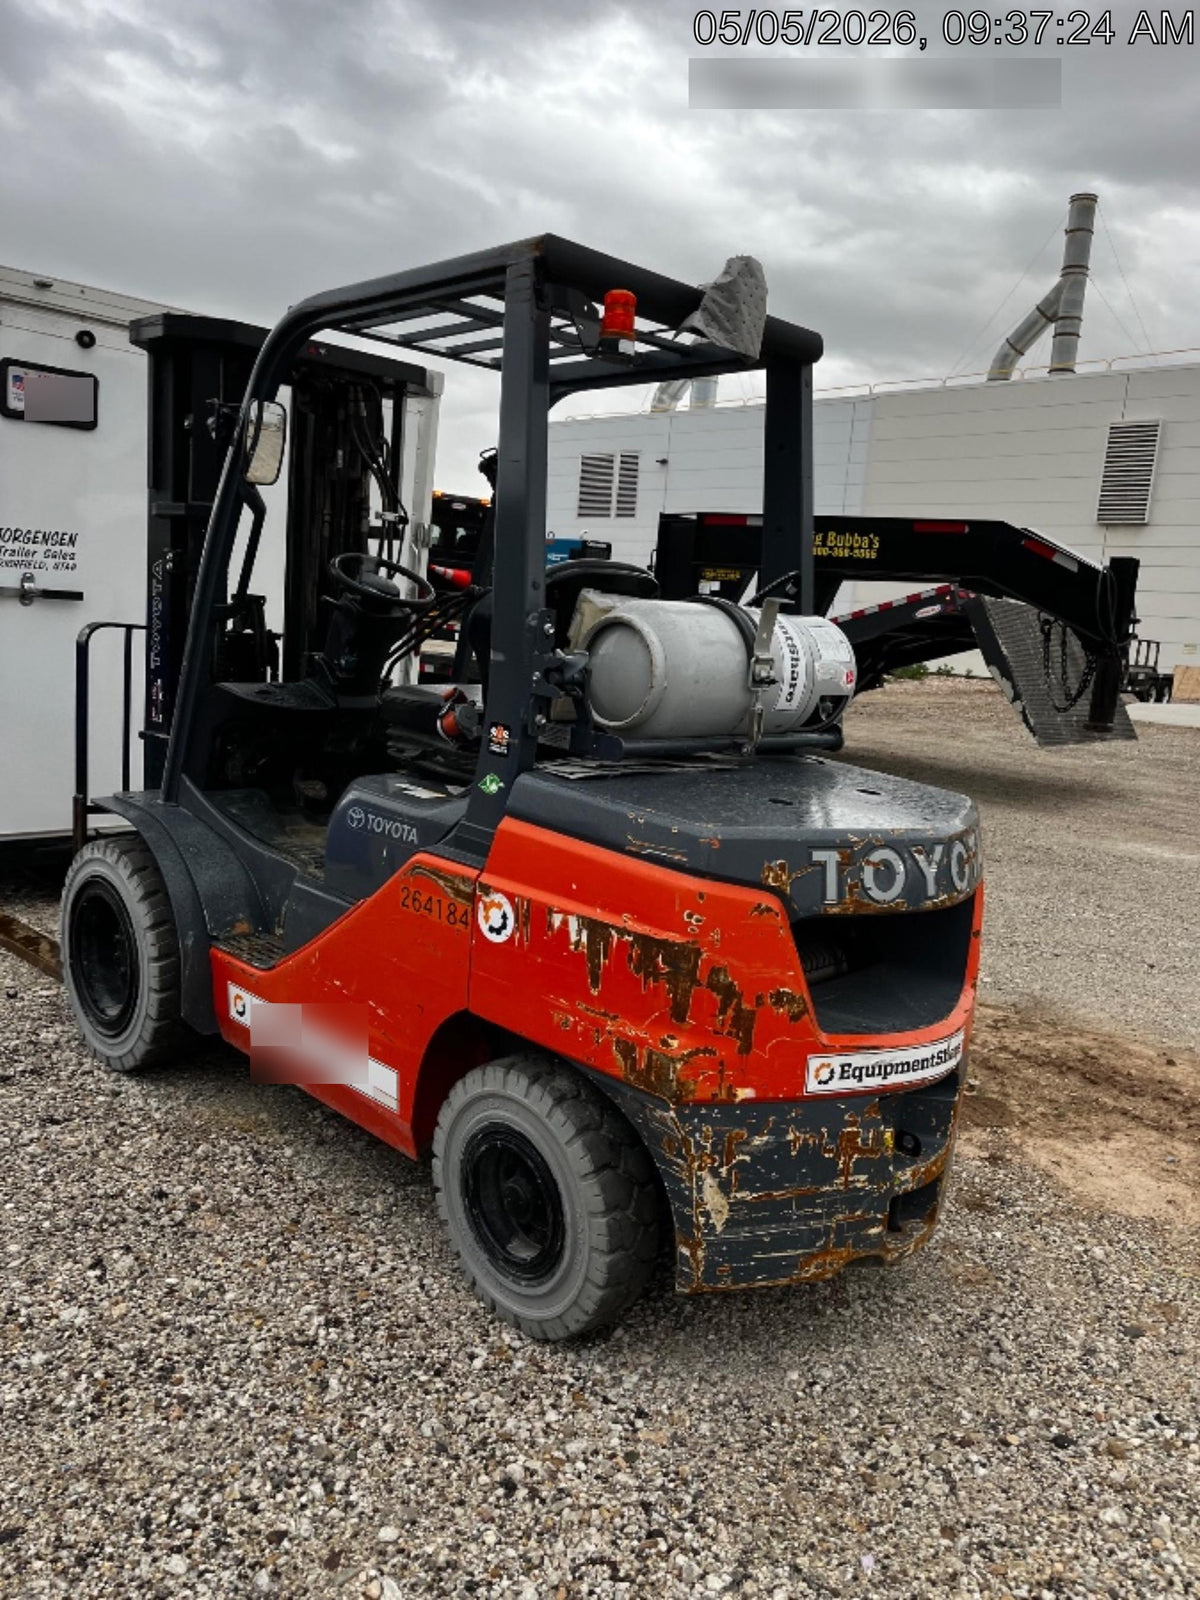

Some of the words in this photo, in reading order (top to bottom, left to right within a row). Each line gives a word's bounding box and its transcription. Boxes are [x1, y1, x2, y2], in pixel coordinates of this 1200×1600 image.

[43, 548, 76, 561] Sales
[827, 531, 880, 549] Bubba's
[151, 559, 163, 669] TOYOTA
[367, 814, 418, 844] TOYOTA
[401, 886, 469, 930] 264184
